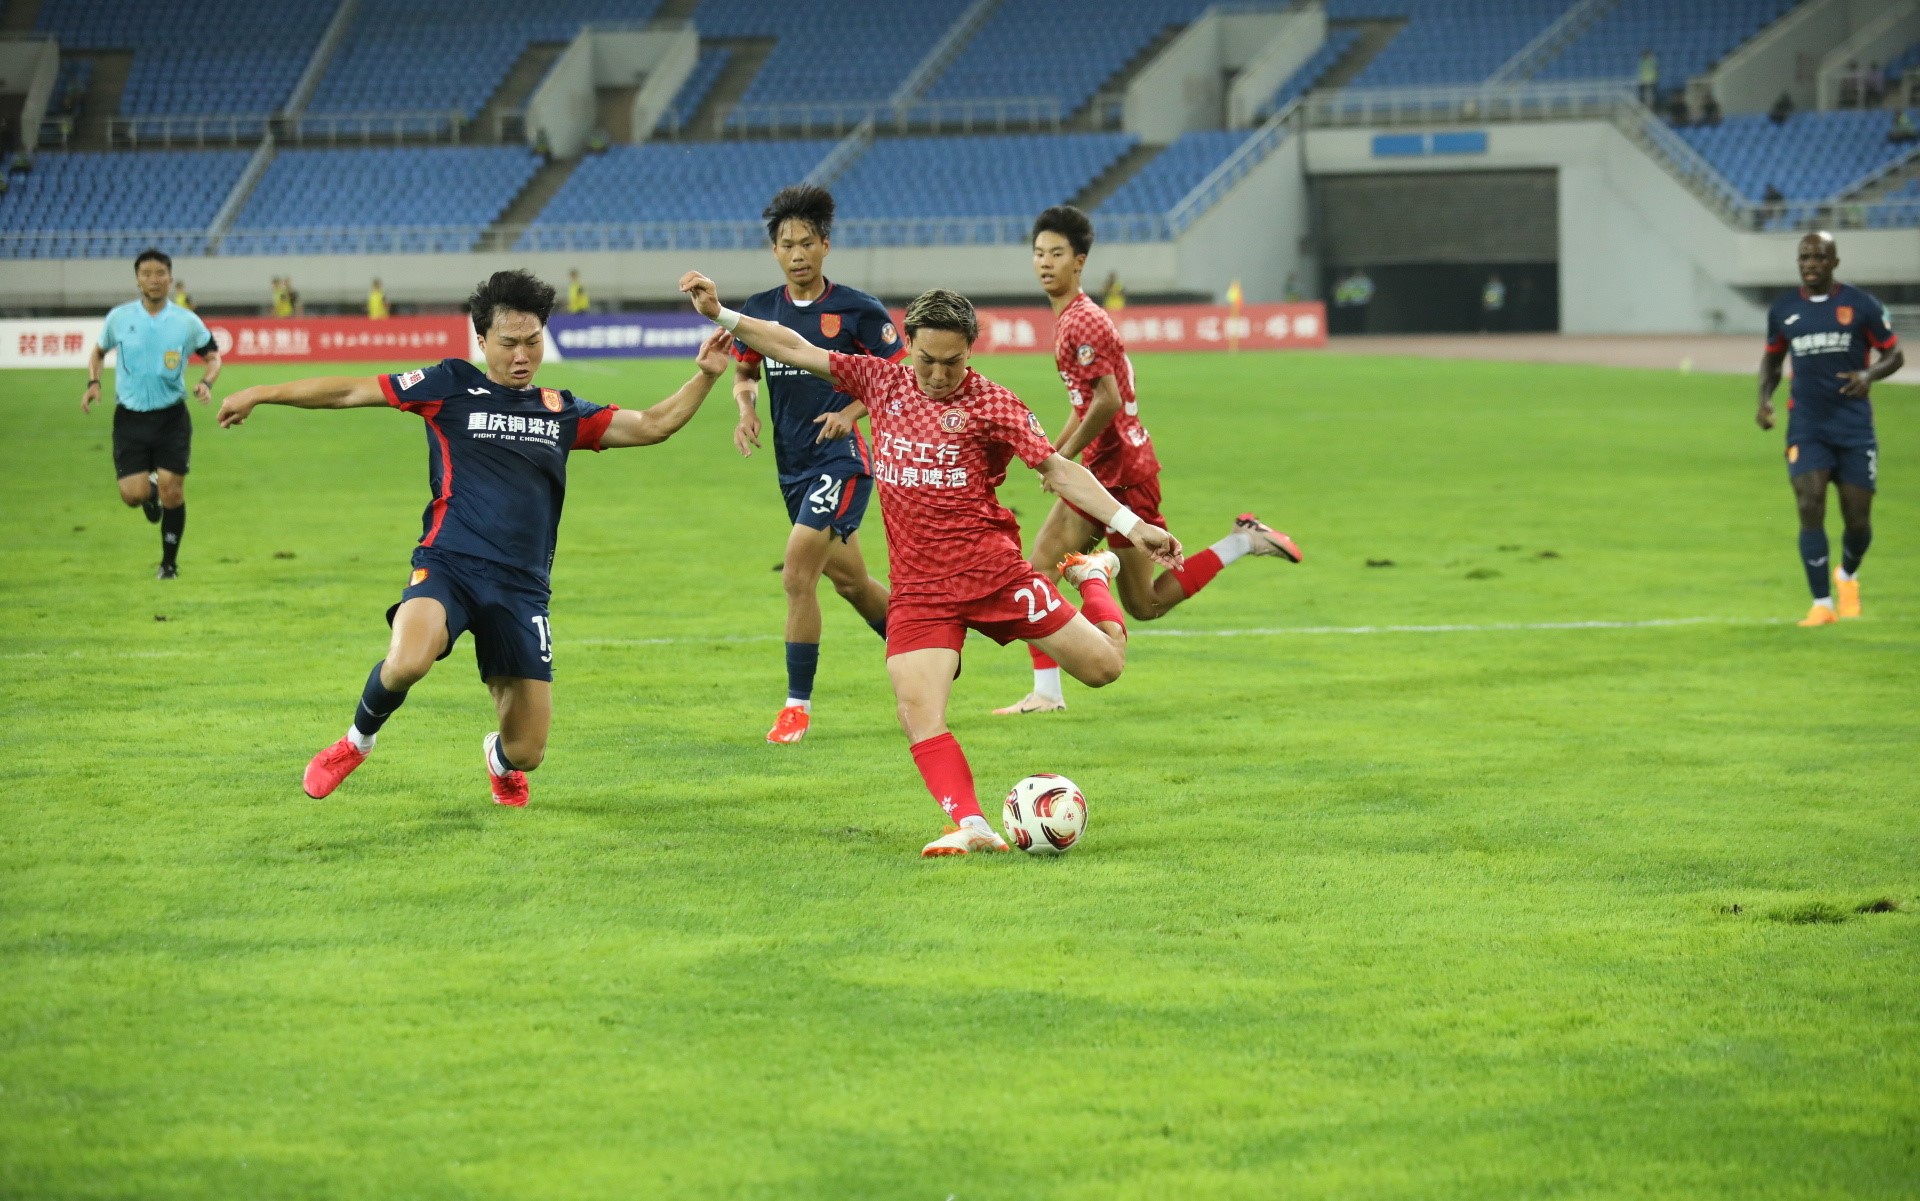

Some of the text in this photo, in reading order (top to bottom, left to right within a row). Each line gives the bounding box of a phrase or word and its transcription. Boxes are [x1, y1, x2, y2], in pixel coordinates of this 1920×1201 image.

[467, 412, 560, 440] 重庆铜梁龙
[880, 430, 960, 466] 辽宁工行
[809, 474, 842, 510] 24
[1014, 578, 1062, 622] 22
